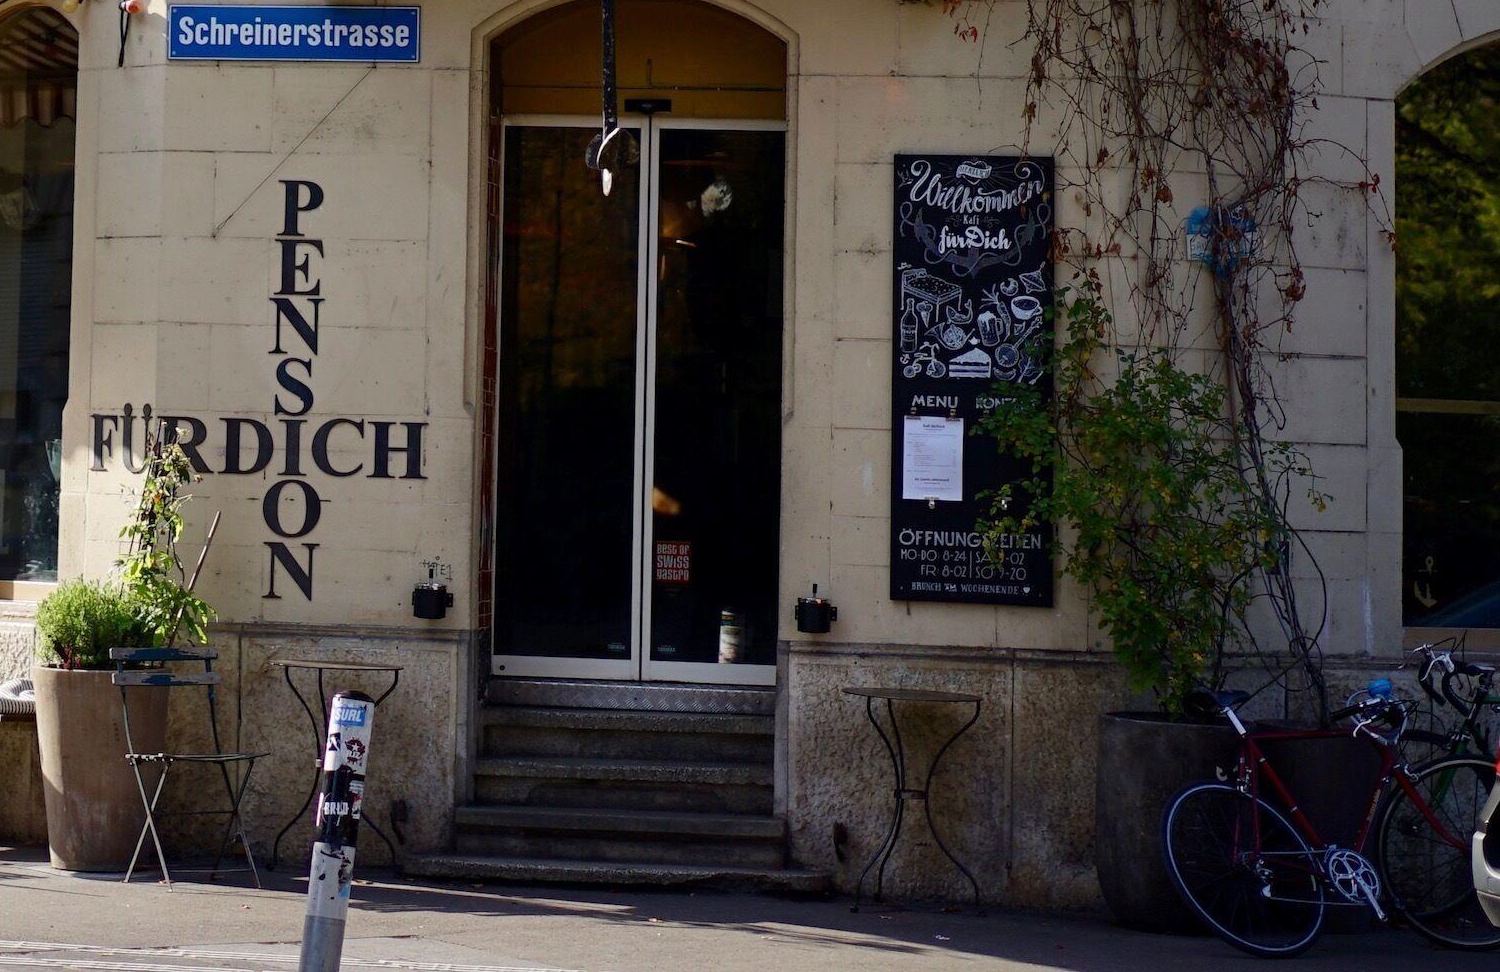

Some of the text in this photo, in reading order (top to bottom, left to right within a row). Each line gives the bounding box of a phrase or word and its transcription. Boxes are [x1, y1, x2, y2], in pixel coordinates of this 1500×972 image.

[178, 15, 410, 47] Schreinerstrasse
[910, 160, 1045, 214] Willkommen
[963, 214, 980, 225] Kafi
[261, 179, 326, 602] PENSION
[912, 394, 959, 408] MENU
[911, 581, 941, 592] BRUNCH
[961, 583, 1019, 595] WOCHENENDE
